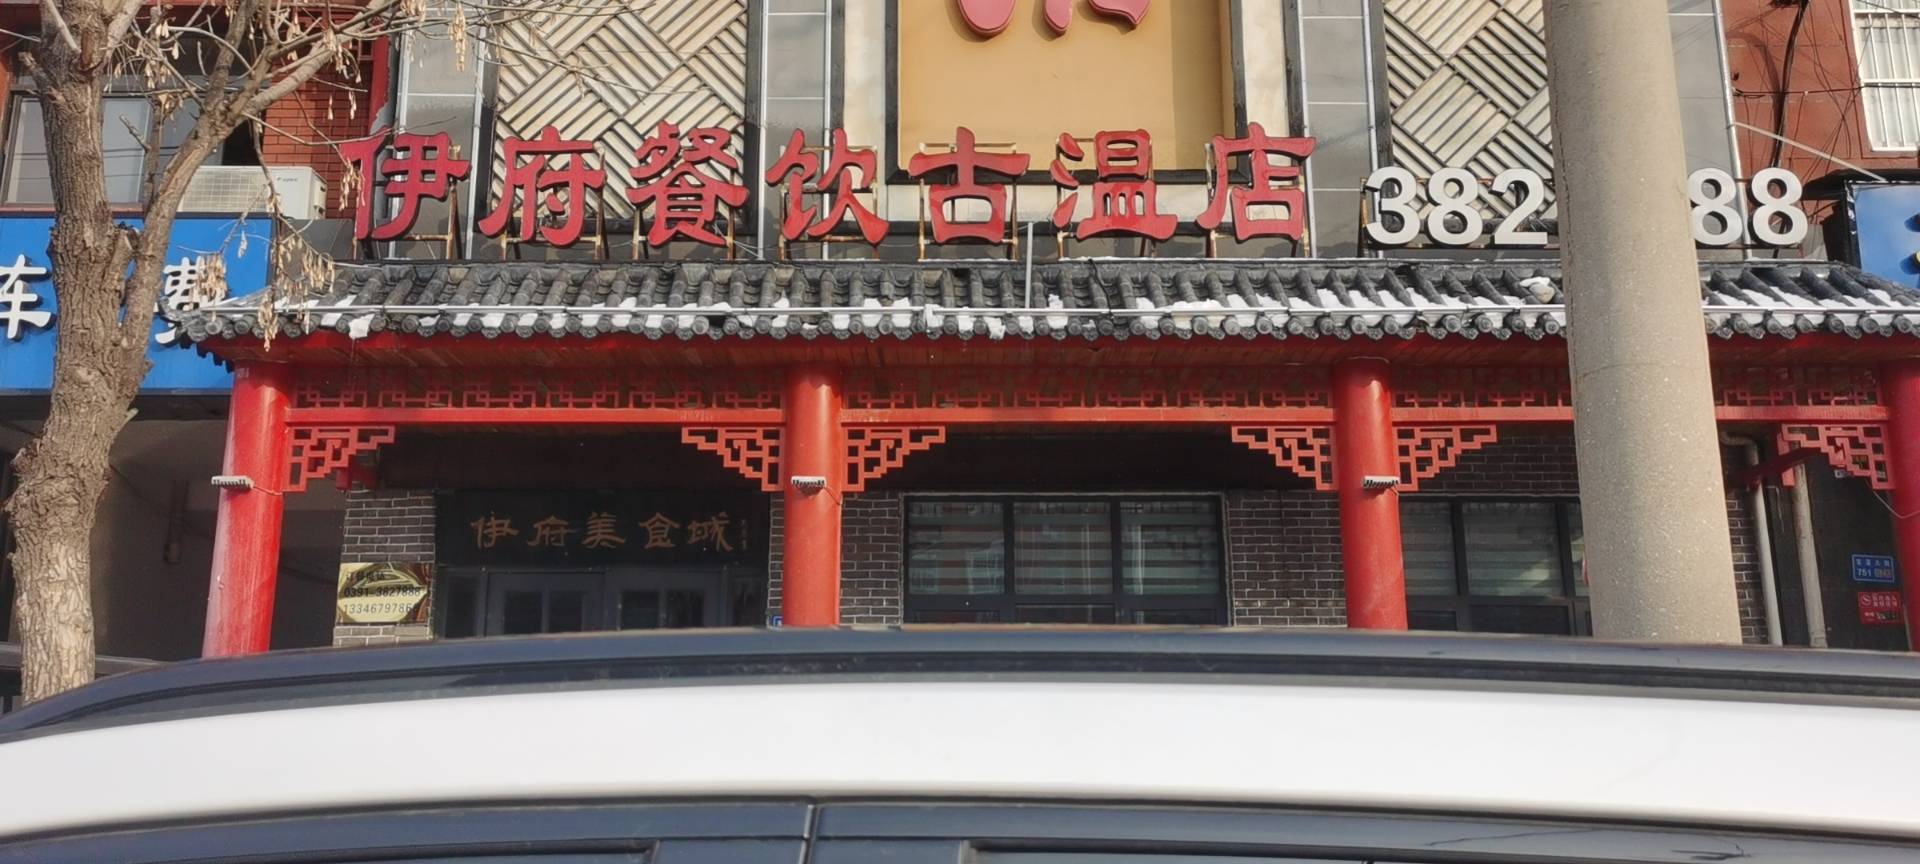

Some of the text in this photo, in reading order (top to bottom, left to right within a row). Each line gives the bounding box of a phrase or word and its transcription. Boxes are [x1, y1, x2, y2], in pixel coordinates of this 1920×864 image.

[339, 122, 1317, 247] 伊府餐饮古温店
[470, 511, 733, 551] 伊府美食城
